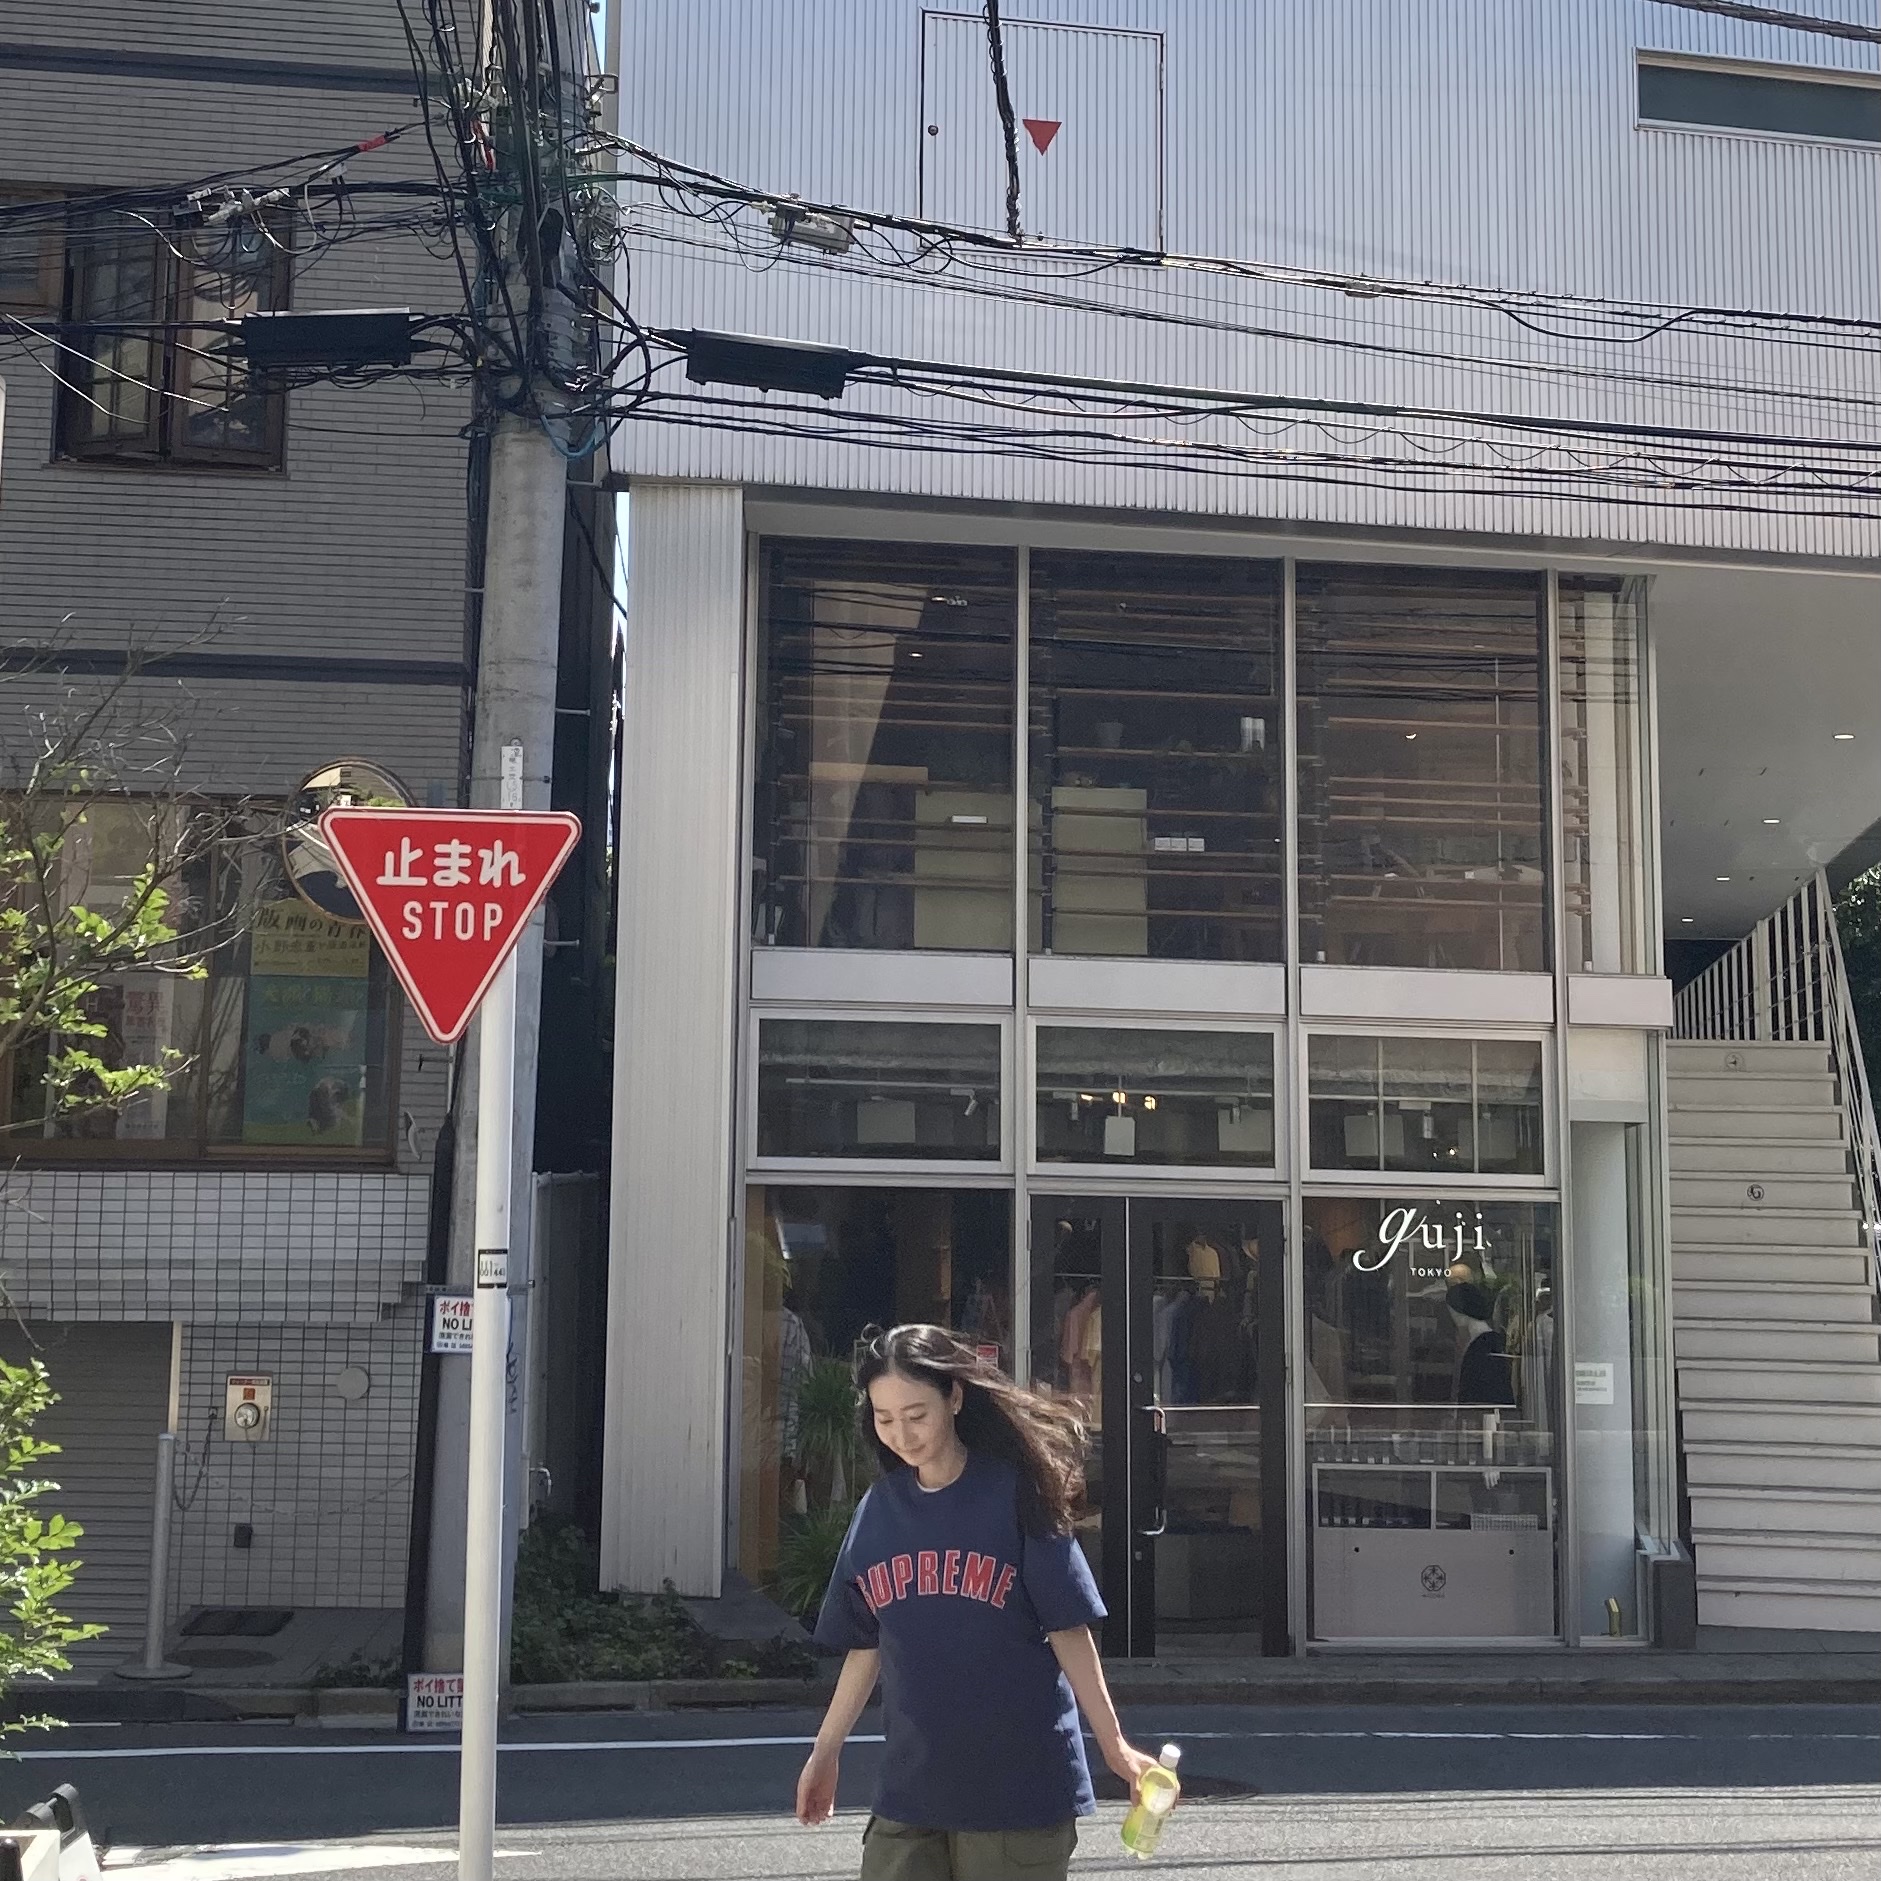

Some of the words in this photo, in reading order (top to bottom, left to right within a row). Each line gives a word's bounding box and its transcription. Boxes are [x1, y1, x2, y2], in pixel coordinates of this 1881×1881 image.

[376, 836, 527, 888] 止まれ
[402, 900, 504, 942] STOP
[1352, 1207, 1486, 1272] guji
[1410, 1267, 1452, 1278] TOKYO
[442, 1317, 459, 1330] NO
[416, 1695, 434, 1708] NO
